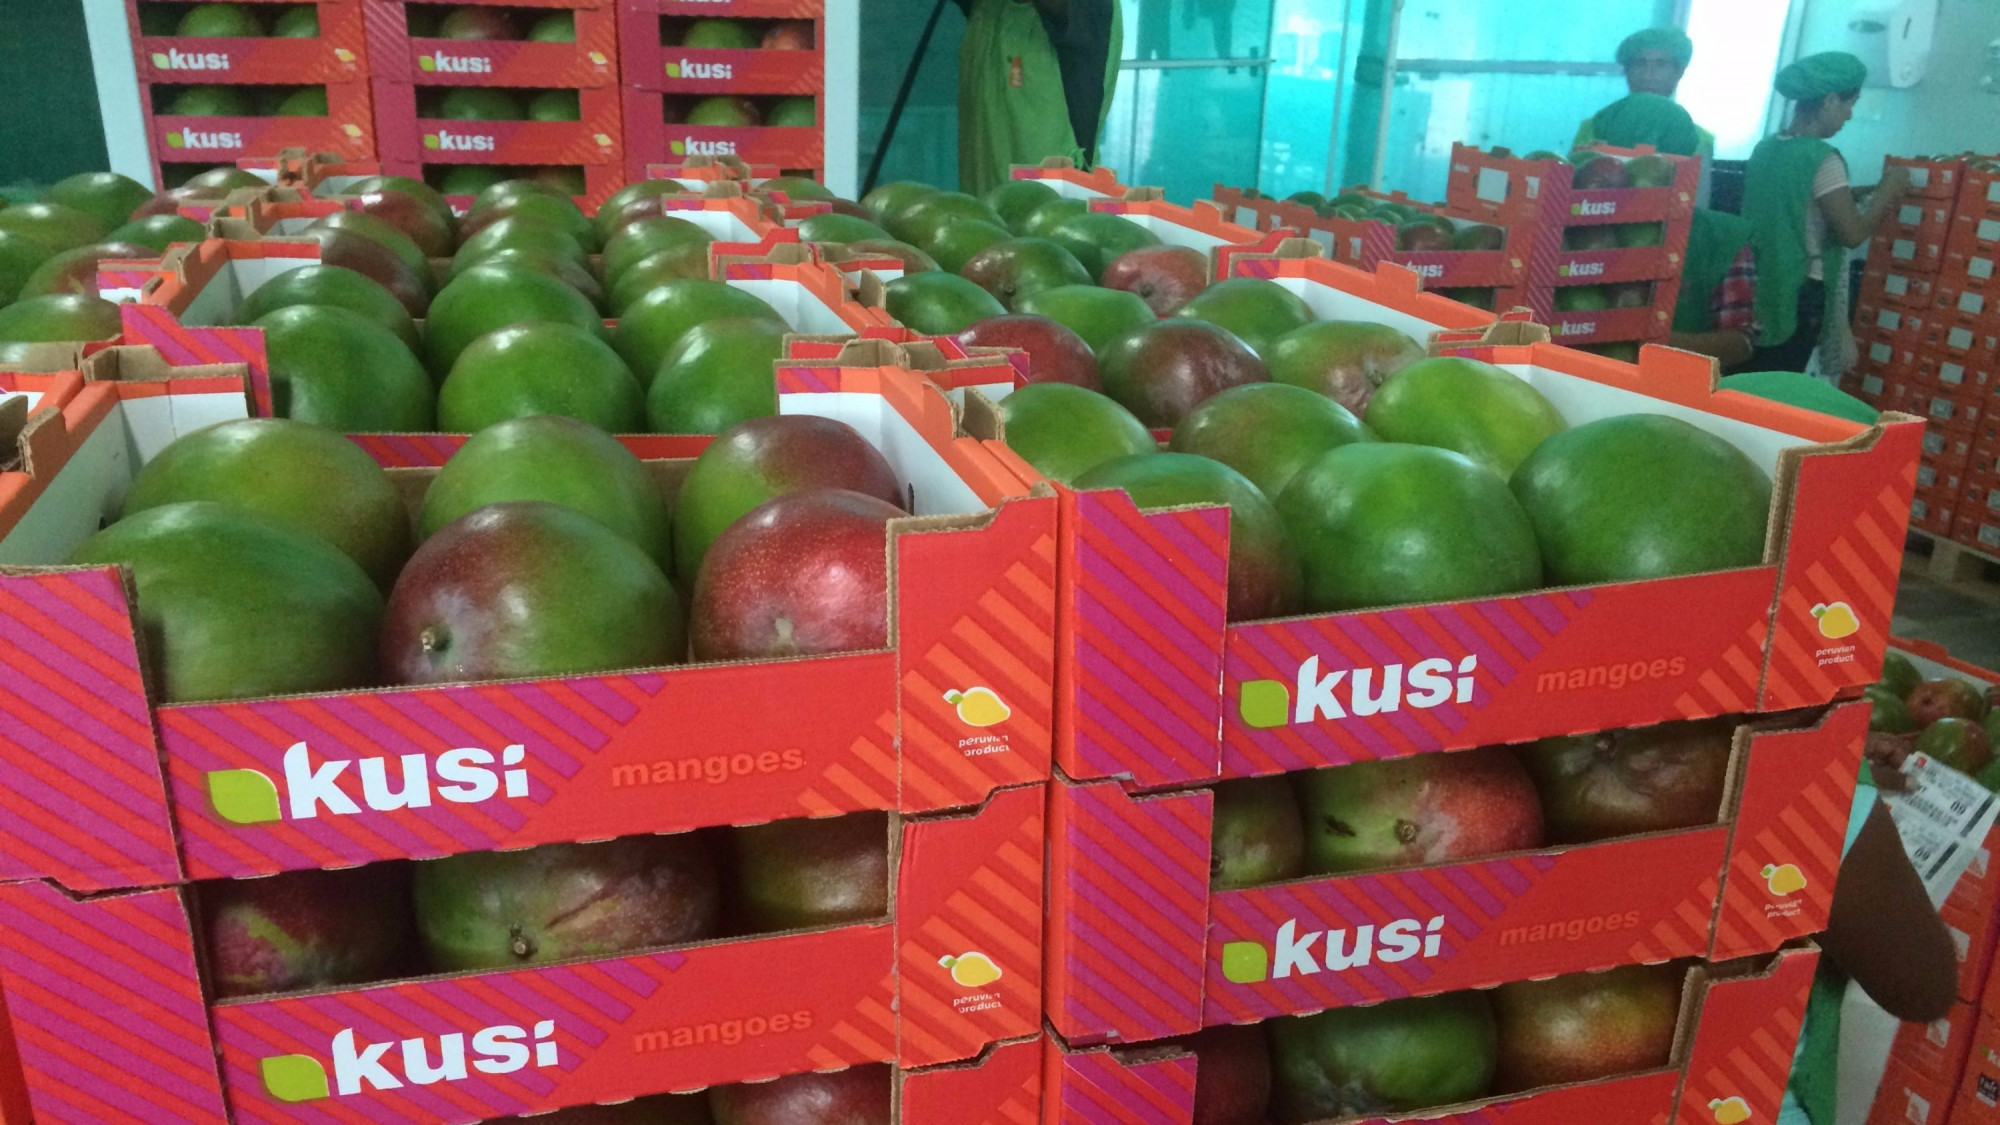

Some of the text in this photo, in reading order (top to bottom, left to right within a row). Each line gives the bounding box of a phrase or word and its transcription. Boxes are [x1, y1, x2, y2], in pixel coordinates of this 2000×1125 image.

[169, 48, 230, 70] kusi
[435, 51, 491, 73] kusi
[680, 58, 732, 79] kusi
[183, 127, 243, 149] kusi
[439, 130, 494, 151] kusi
[685, 136, 736, 155] kusi
[1580, 199, 1616, 216] kusi
[1569, 261, 1604, 277] kusi
[1561, 321, 1595, 335] kusi
[1815, 645, 1855, 657] peruvian
[1818, 654, 1854, 667] product
[1295, 654, 1687, 723] kusi mangoes
[283, 742, 803, 819] kusi mangoes
[1273, 910, 1640, 979] kusi mangoes
[331, 1009, 813, 1096] kusi mangoes
